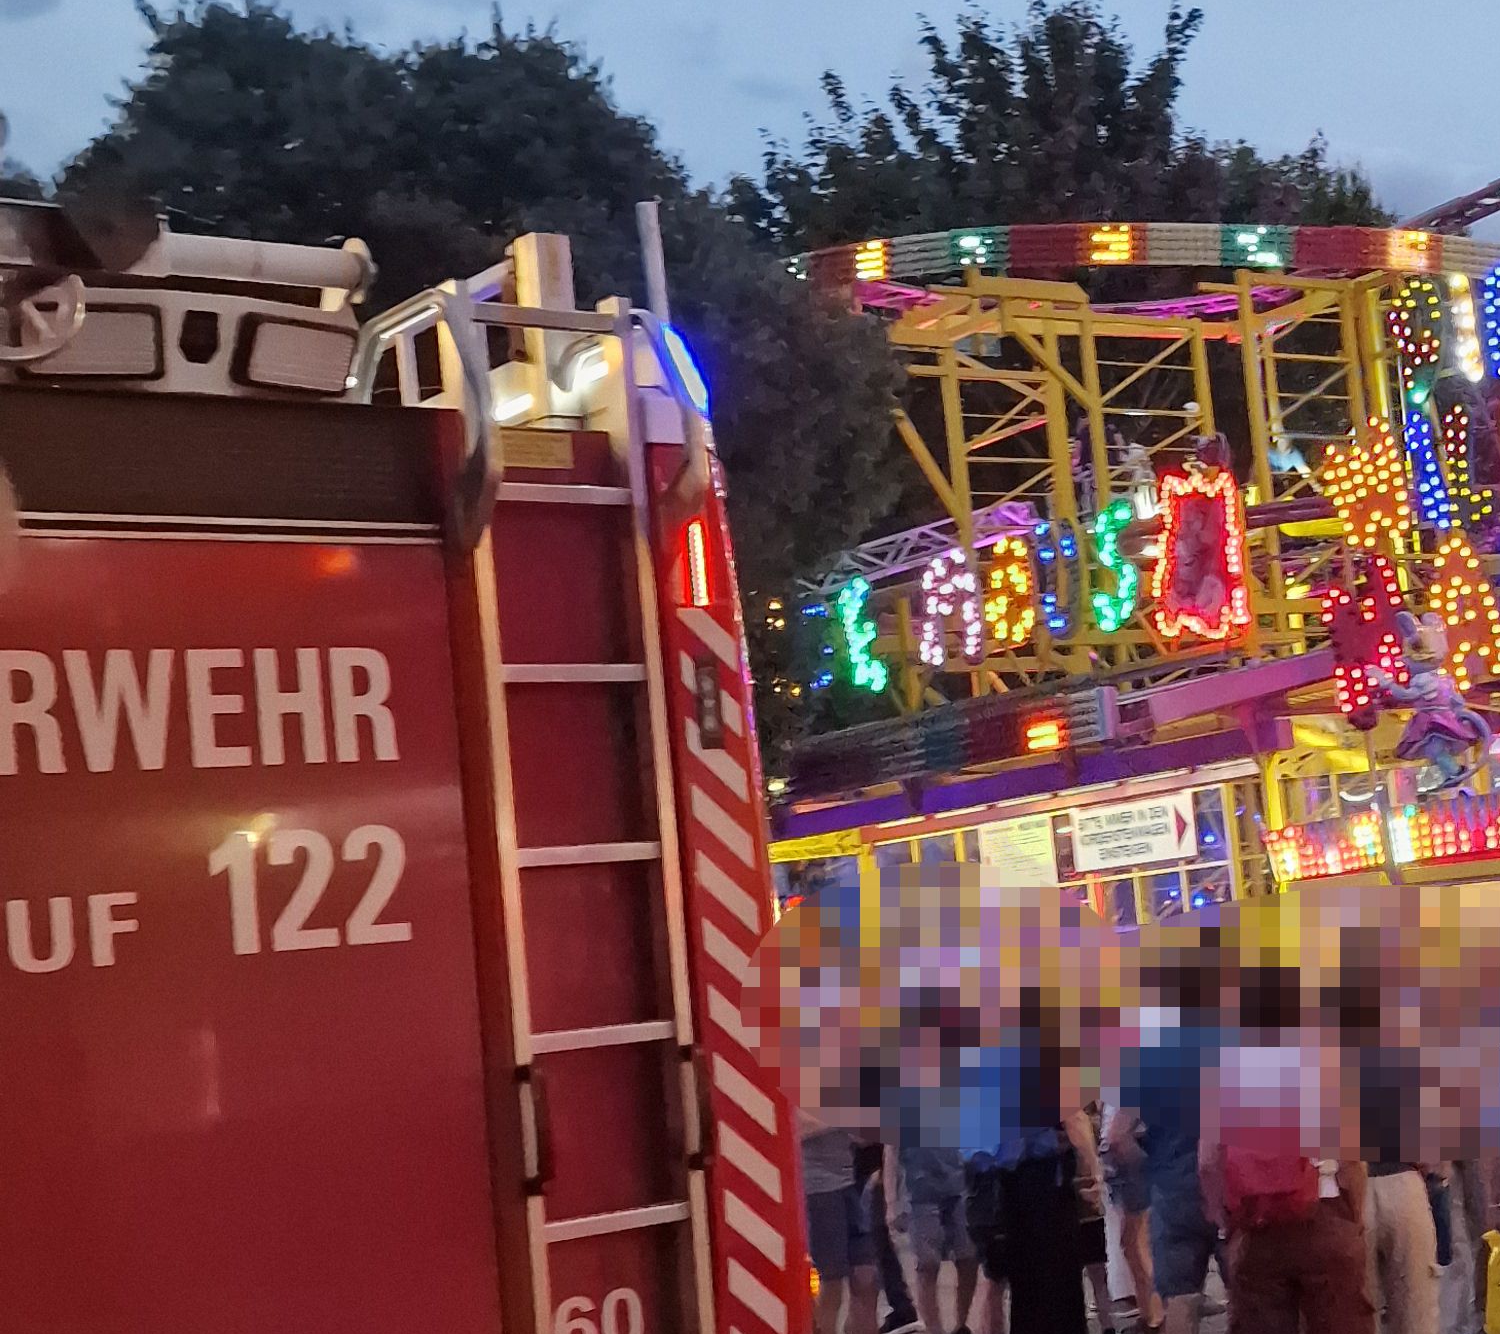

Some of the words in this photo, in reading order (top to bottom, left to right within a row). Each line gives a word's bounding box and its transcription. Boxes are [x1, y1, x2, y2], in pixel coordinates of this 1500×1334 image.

[0, 647, 400, 775] RWEHR
[6, 892, 139, 974] UF
[208, 823, 412, 955] 122
